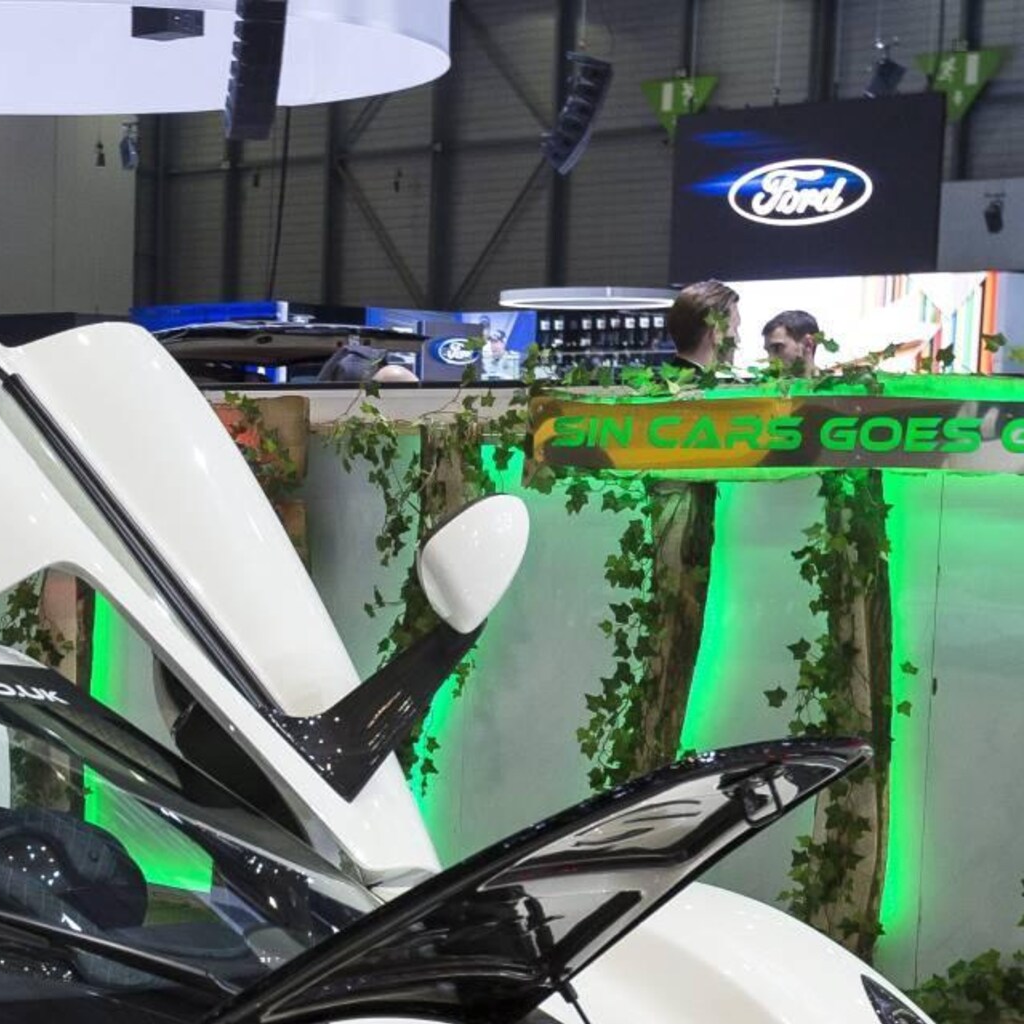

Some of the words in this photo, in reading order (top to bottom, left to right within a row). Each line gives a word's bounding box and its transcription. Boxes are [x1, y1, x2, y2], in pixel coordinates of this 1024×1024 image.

[751, 169, 848, 216] Ford
[551, 416, 633, 448] SIN
[647, 416, 804, 450] CARS
[820, 418, 982, 453] GOES
